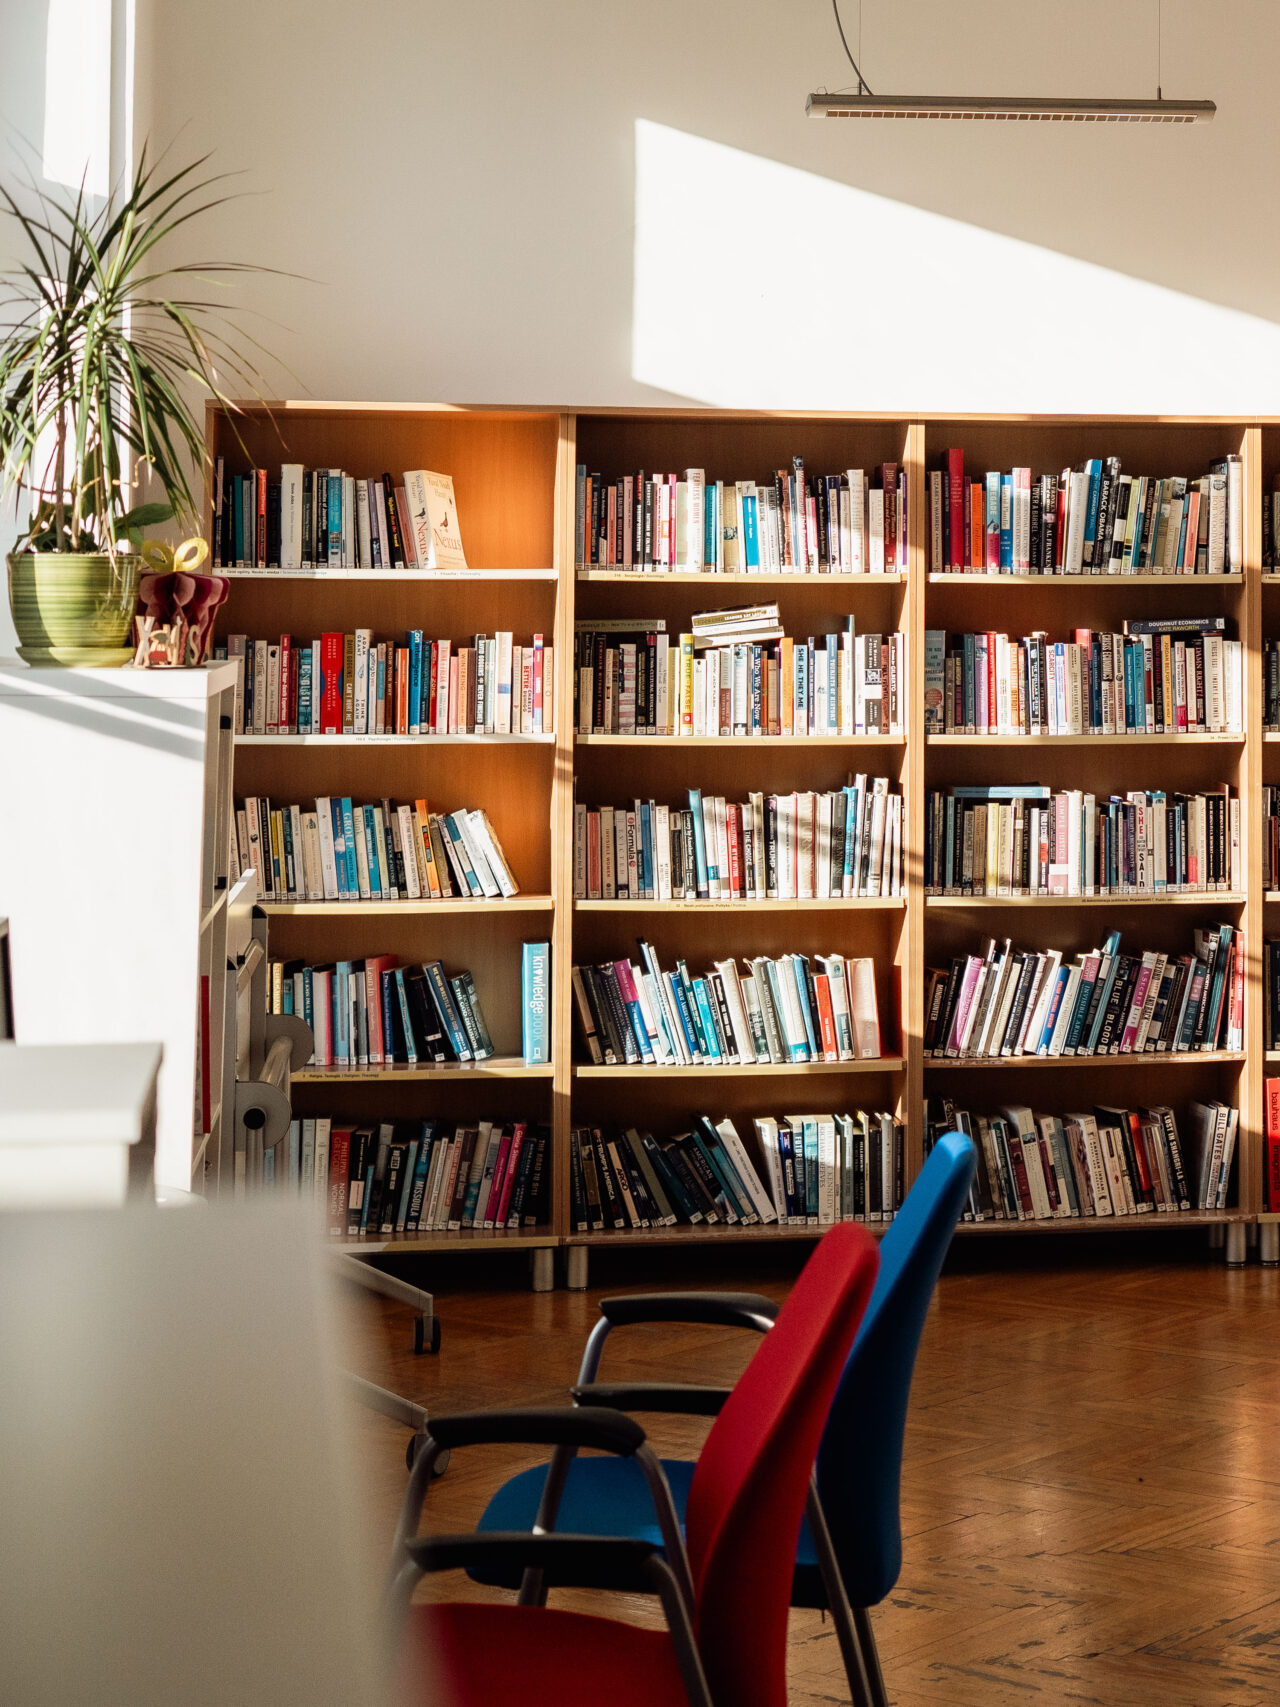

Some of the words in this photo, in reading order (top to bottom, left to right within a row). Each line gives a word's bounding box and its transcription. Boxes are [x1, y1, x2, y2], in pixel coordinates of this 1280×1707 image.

[1101, 480, 1110, 510] BARACK
[416, 520, 428, 555] Nexus
[433, 528, 462, 551] Nexus
[1097, 512, 1107, 541] OBAMA
[412, 643, 421, 688] intelligence
[684, 658, 692, 677] TRUE
[796, 648, 804, 661] SHE
[796, 663, 804, 673] HE
[1048, 649, 1056, 681] SCARCITY
[754, 673, 761, 684] We
[796, 676, 804, 695] THEY
[684, 685, 692, 710] FALSE
[796, 697, 804, 709] ME
[345, 712, 353, 721] ME
[354, 814, 363, 835] blink
[435, 975, 444, 986] WHO
[445, 1007, 454, 1018] WITH
[930, 984, 944, 1021] MINDHUNTER
[1076, 985, 1089, 1018] INVISIBLE
[1110, 980, 1123, 1005] BLUE
[459, 1002, 467, 1015] GOD
[462, 1017, 477, 1047] DELUSION
[1070, 1019, 1082, 1047] ARMIES
[1101, 1014, 1116, 1044] BLOOD
[425, 1128, 433, 1137] Jon
[1217, 1112, 1226, 1132] BILL
[420, 1138, 431, 1164] Krakauer
[514, 1130, 523, 1149] Gloria
[1164, 1114, 1173, 1131] LOST
[1170, 1140, 1184, 1180] SHANGRI-LA
[1214, 1133, 1225, 1160] GATES
[333, 1137, 341, 1178] GREGORY
[340, 1142, 348, 1174] PHILIPPA
[509, 1150, 519, 1174] Steinem
[596, 1143, 608, 1170] TRUMP'S
[603, 1171, 615, 1200] AMERICA
[616, 1167, 629, 1191] ARGO
[331, 1184, 339, 1216] WOMEN
[337, 1183, 345, 1217] NORMAL
[409, 1180, 425, 1217] MISSOULA
